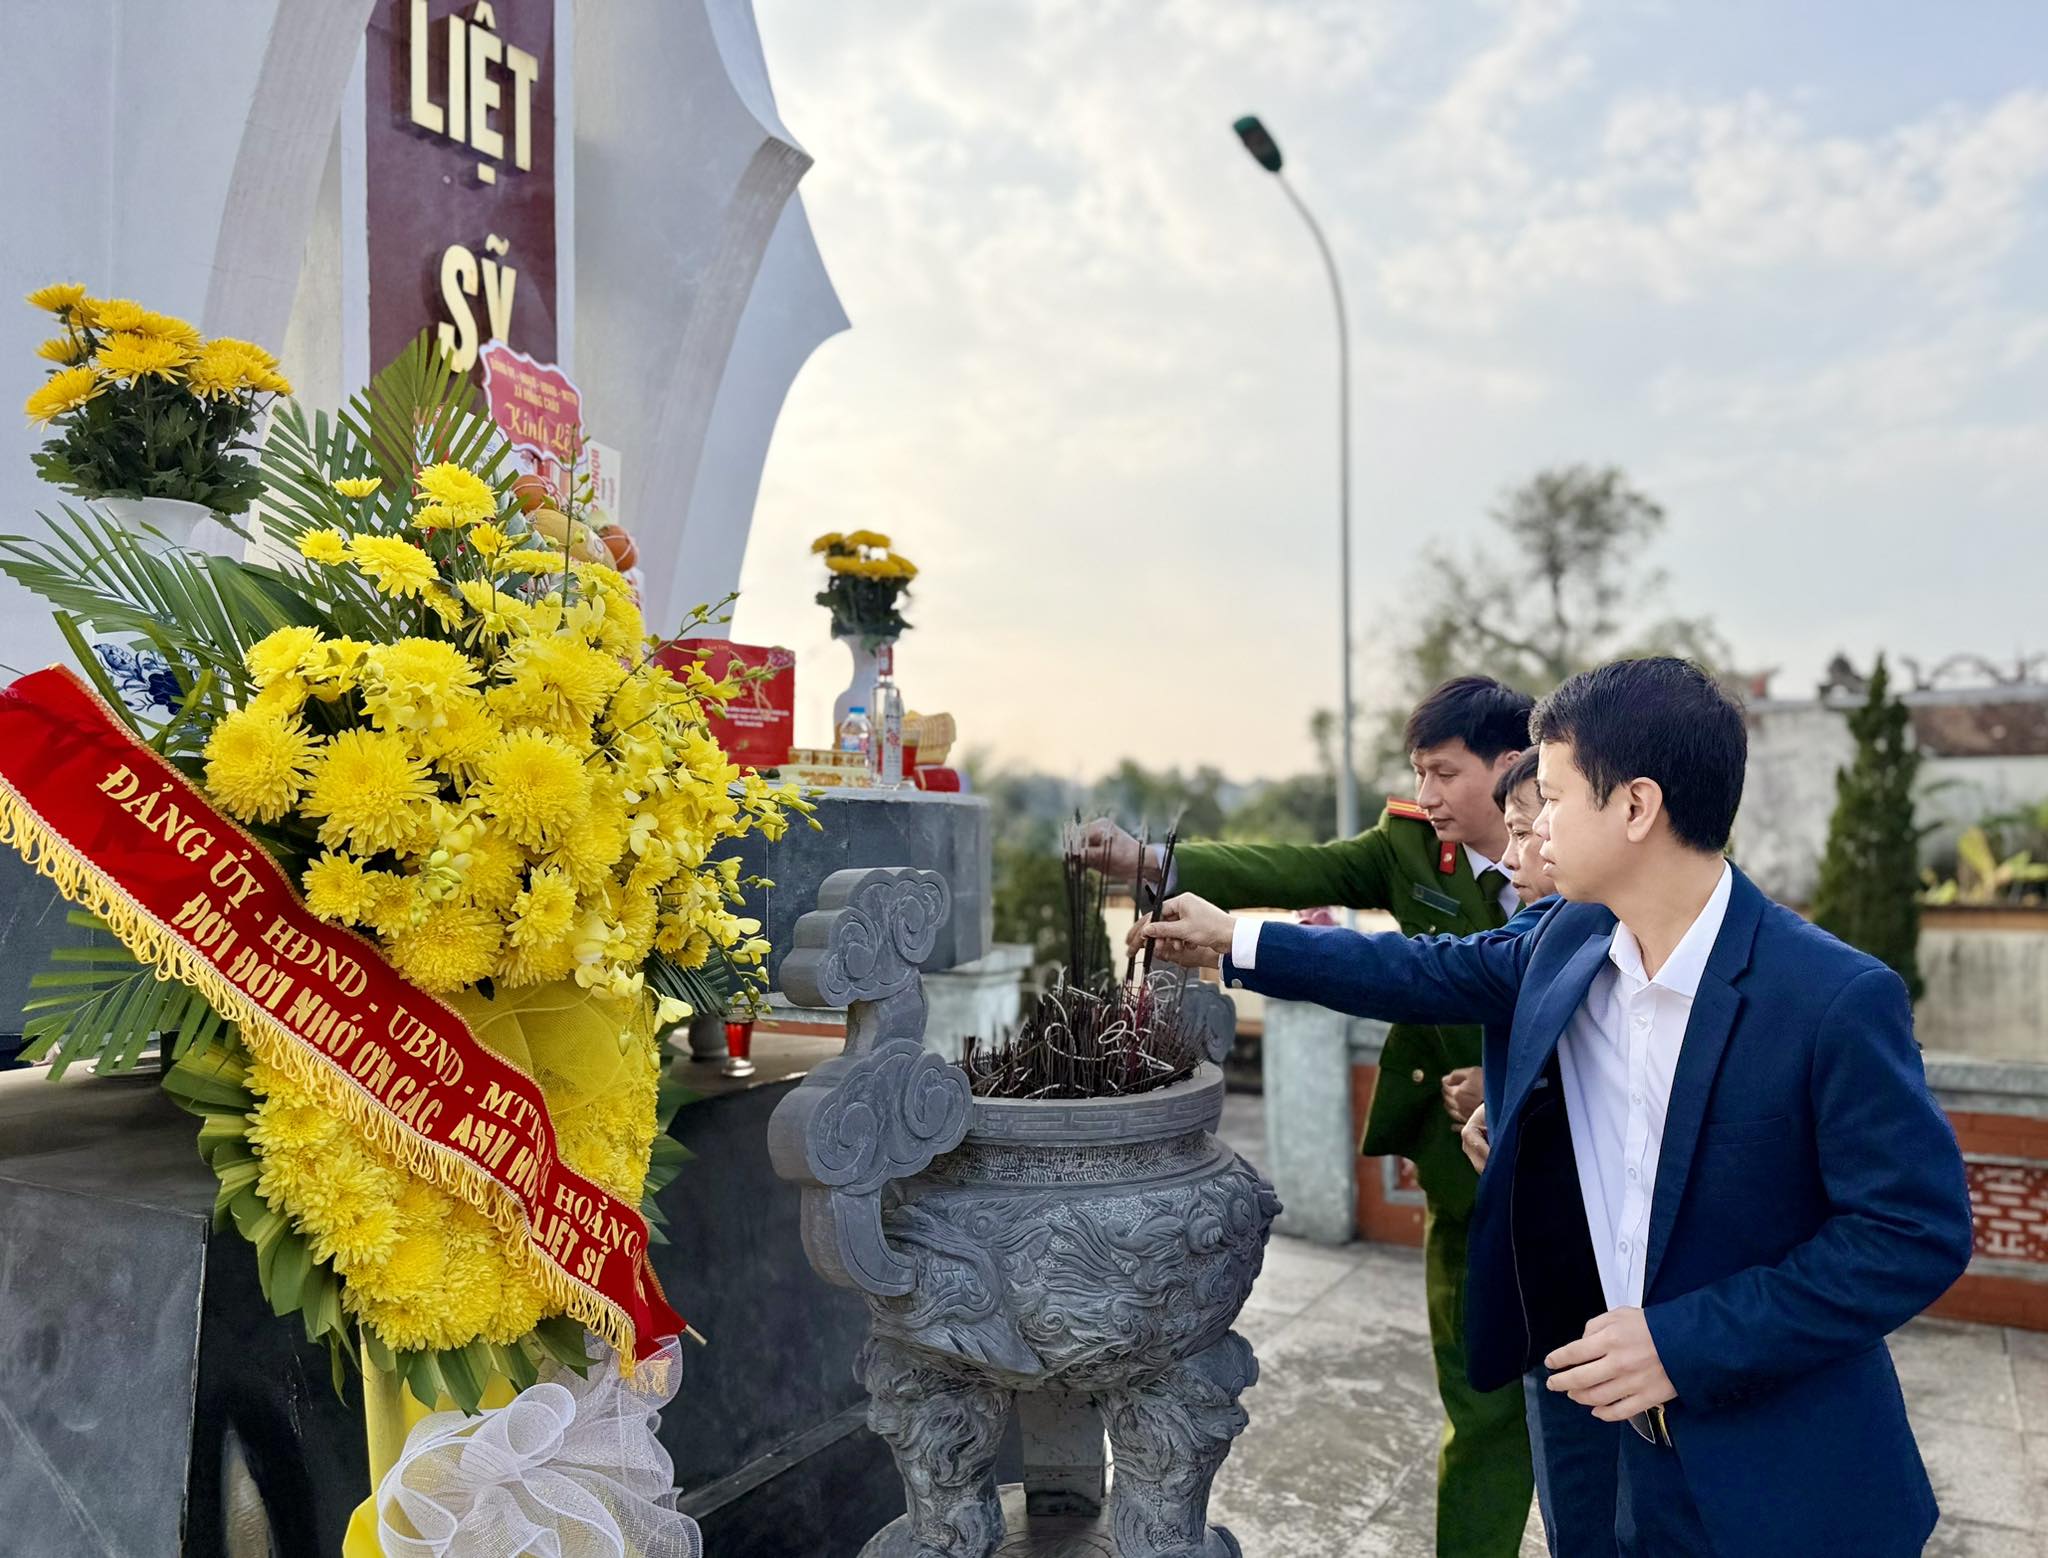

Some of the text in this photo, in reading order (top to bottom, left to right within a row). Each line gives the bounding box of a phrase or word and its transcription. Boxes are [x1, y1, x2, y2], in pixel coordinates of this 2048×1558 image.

[411, 0, 538, 185] LIỆT
[438, 233, 517, 373] SỸ
[96, 764, 216, 862] ĐẢNG
[210, 849, 264, 909] ỦY
[260, 914, 368, 998] HĐND
[388, 1004, 464, 1087] UBND
[171, 891, 239, 962] ĐỜI
[226, 945, 295, 1010] ĐỜI
[284, 987, 364, 1057] NHỚ
[351, 1040, 397, 1096] ƠN
[386, 1075, 443, 1135] CÁC
[449, 1113, 517, 1170] ANH
[531, 1205, 580, 1266] LIỆT
[577, 1245, 612, 1287] SĨ
